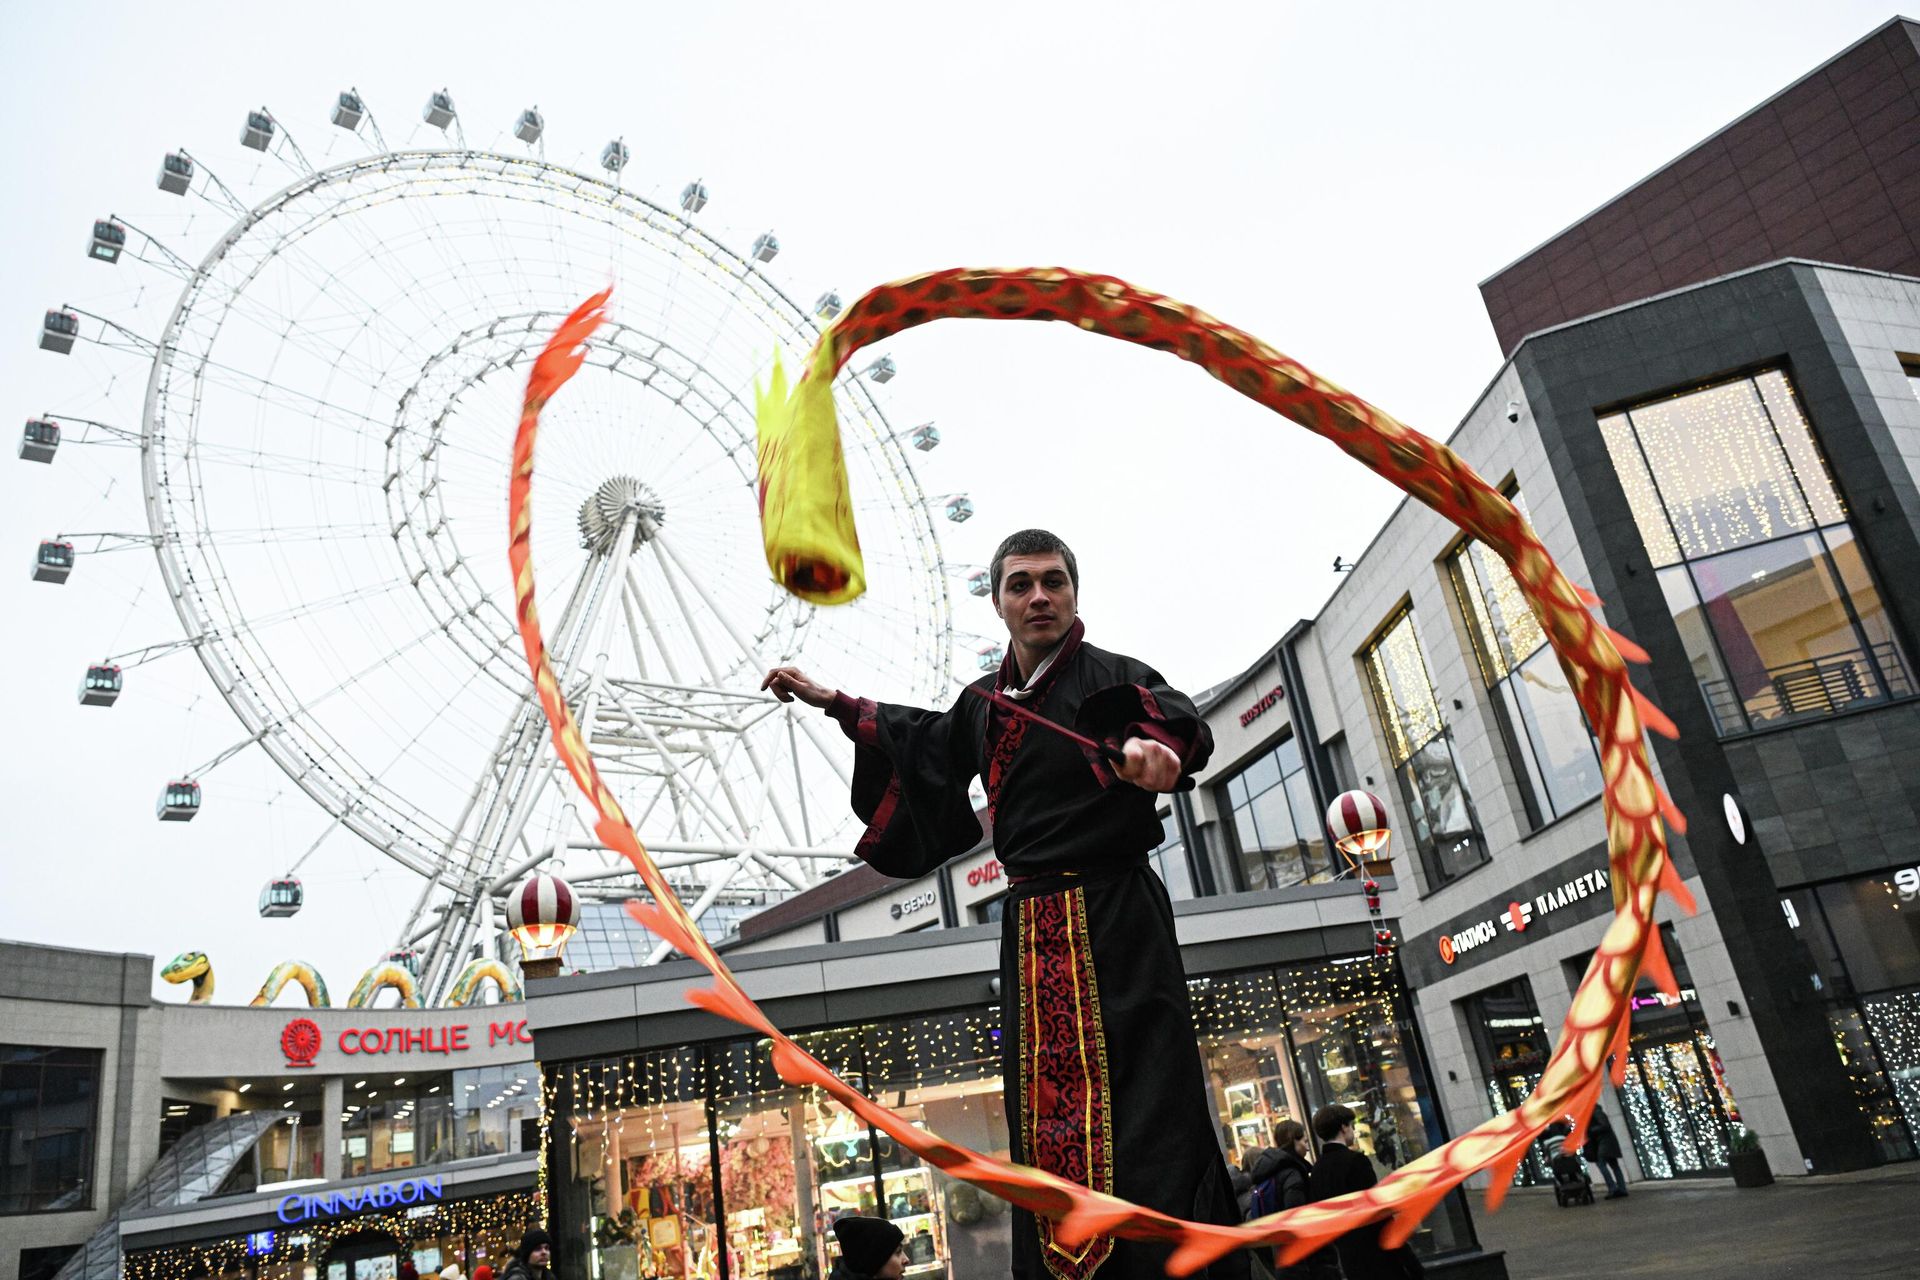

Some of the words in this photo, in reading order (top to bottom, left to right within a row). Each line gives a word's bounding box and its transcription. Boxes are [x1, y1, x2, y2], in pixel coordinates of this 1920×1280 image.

[902, 889, 936, 914] GEMO
[1536, 869, 1607, 916] ПЛАНЕТА
[338, 1024, 470, 1056] СОЛНЦЕ
[277, 1175, 443, 1224] CINNABON
